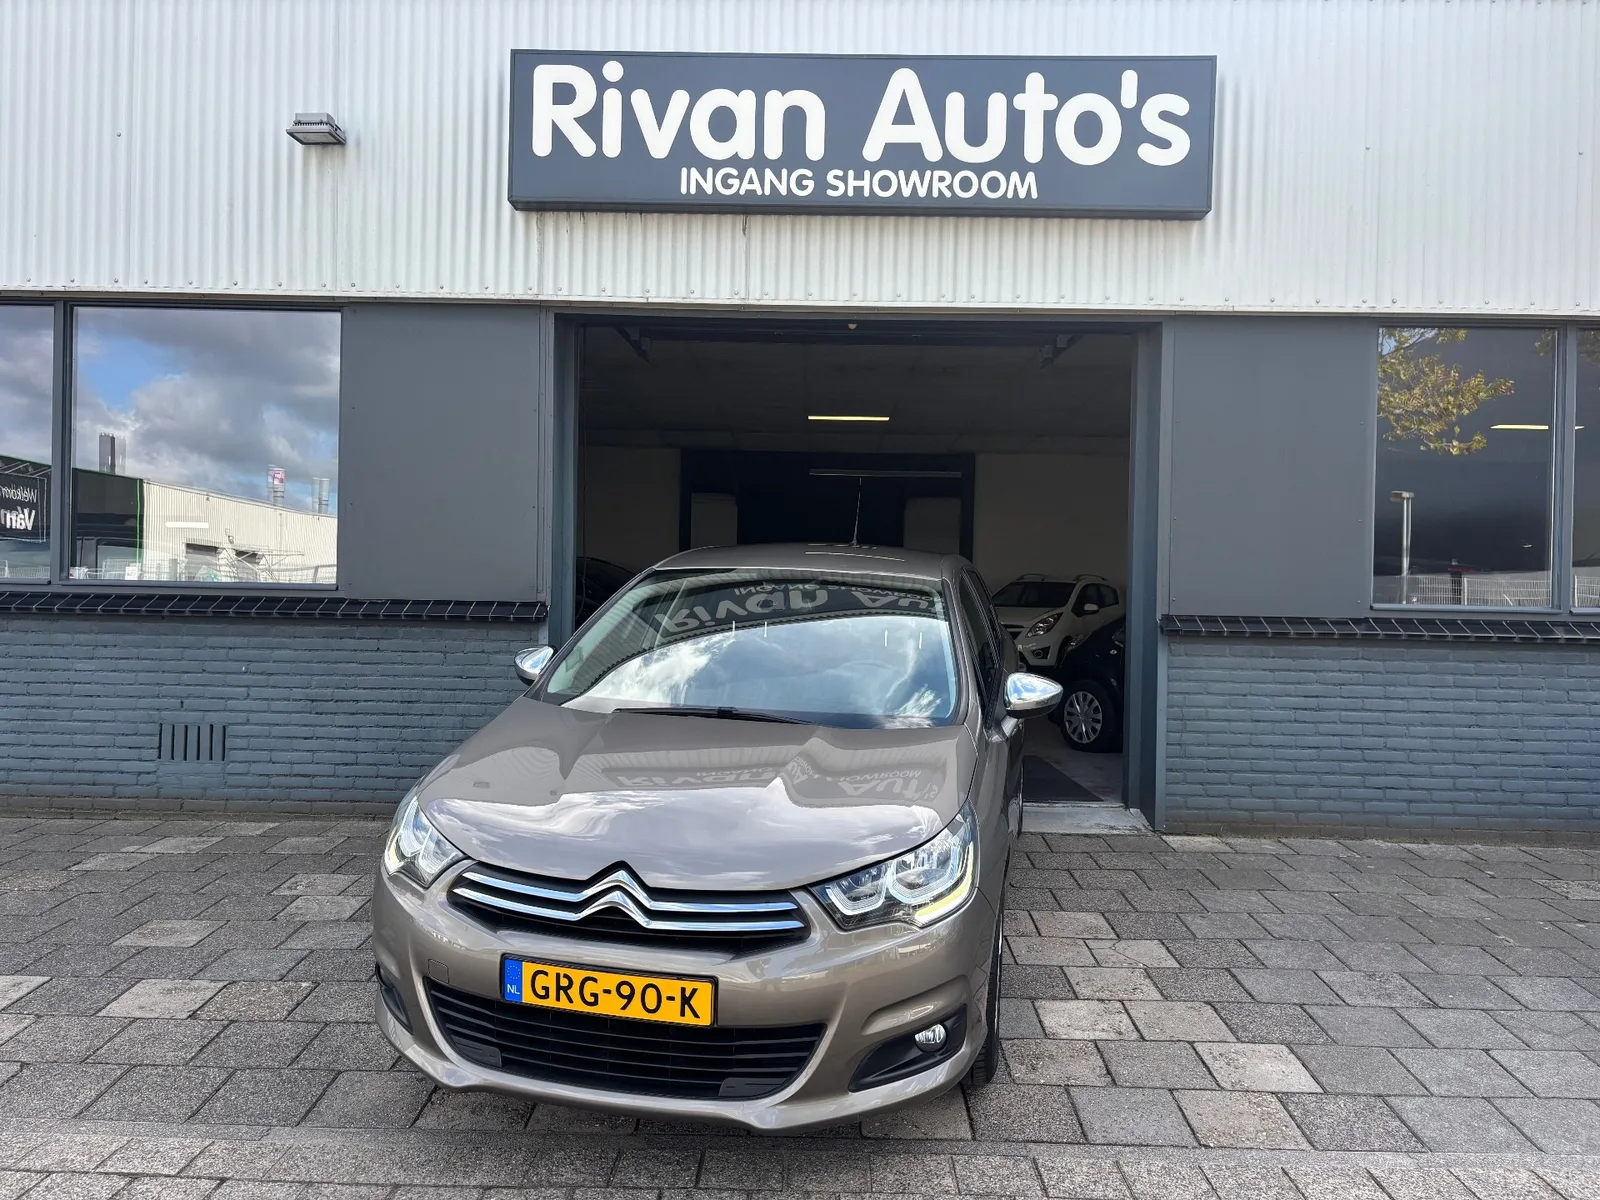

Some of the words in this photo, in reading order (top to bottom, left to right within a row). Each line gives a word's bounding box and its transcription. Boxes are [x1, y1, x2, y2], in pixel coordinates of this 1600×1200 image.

[531, 61, 826, 162] Rivan
[862, 67, 1191, 167] Auto's
[679, 167, 815, 198] INGANG
[825, 169, 1039, 200] SHOWROOM
[507, 983, 521, 995] NL
[530, 969, 701, 1019] GRG-90-K
